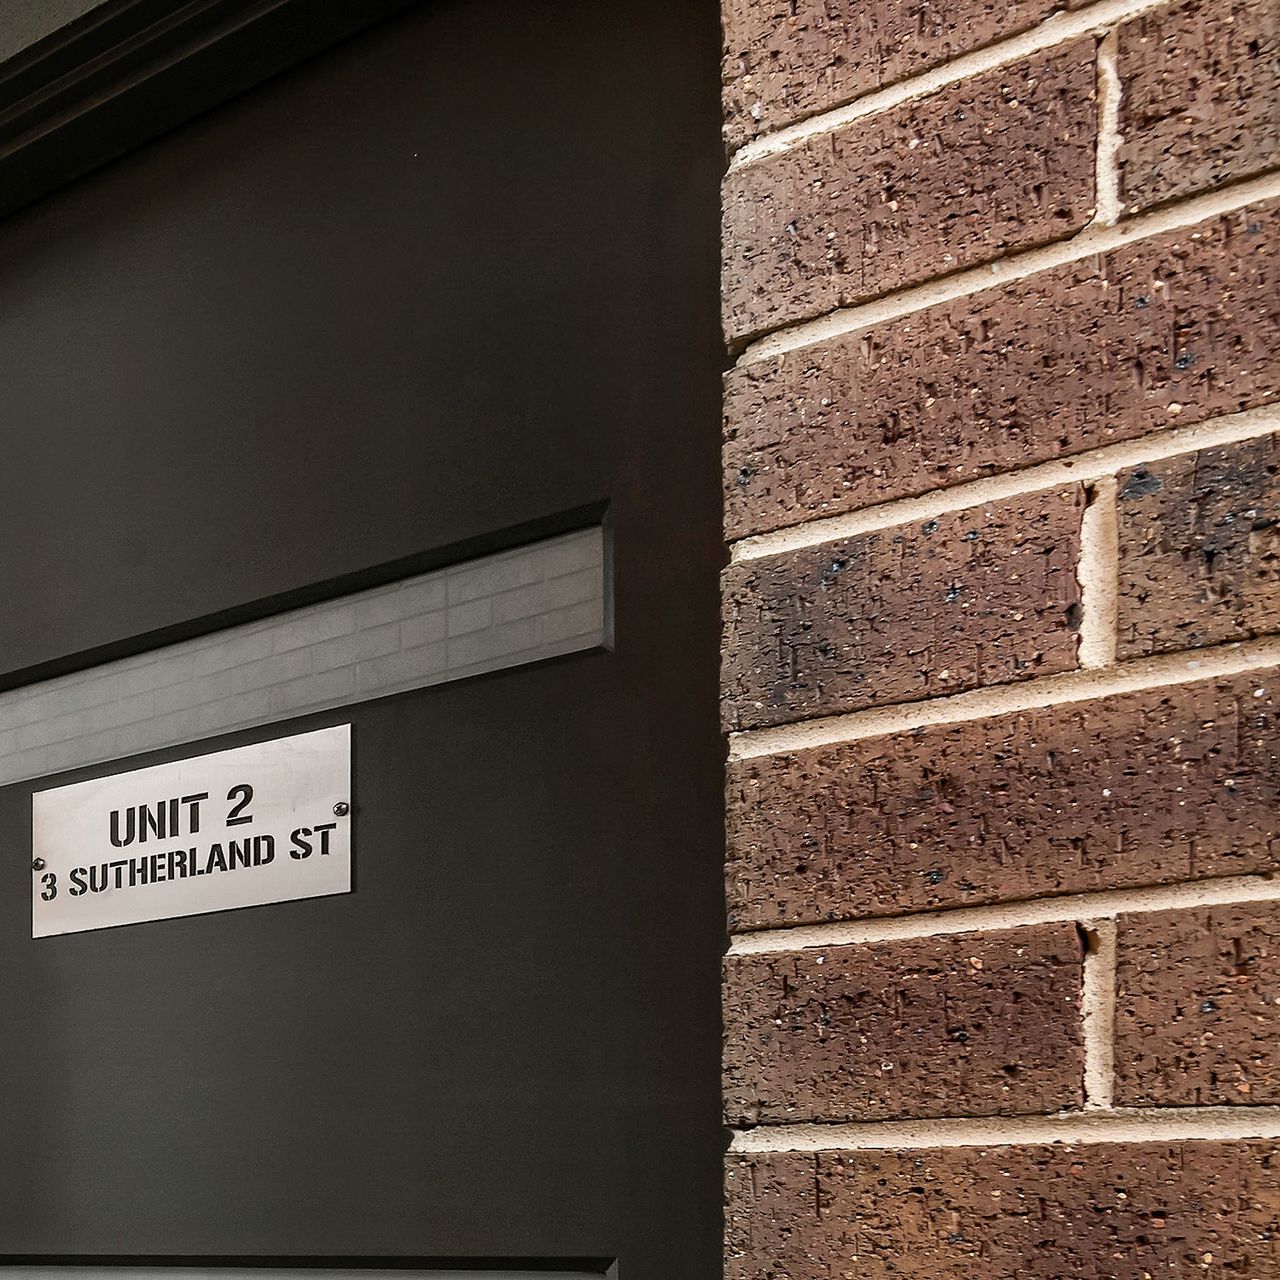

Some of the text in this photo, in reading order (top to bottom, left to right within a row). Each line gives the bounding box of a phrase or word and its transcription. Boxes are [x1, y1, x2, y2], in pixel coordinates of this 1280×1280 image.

[110, 784, 254, 848] UNIT 2
[41, 823, 337, 901] 3 SUTHERLAND ST
